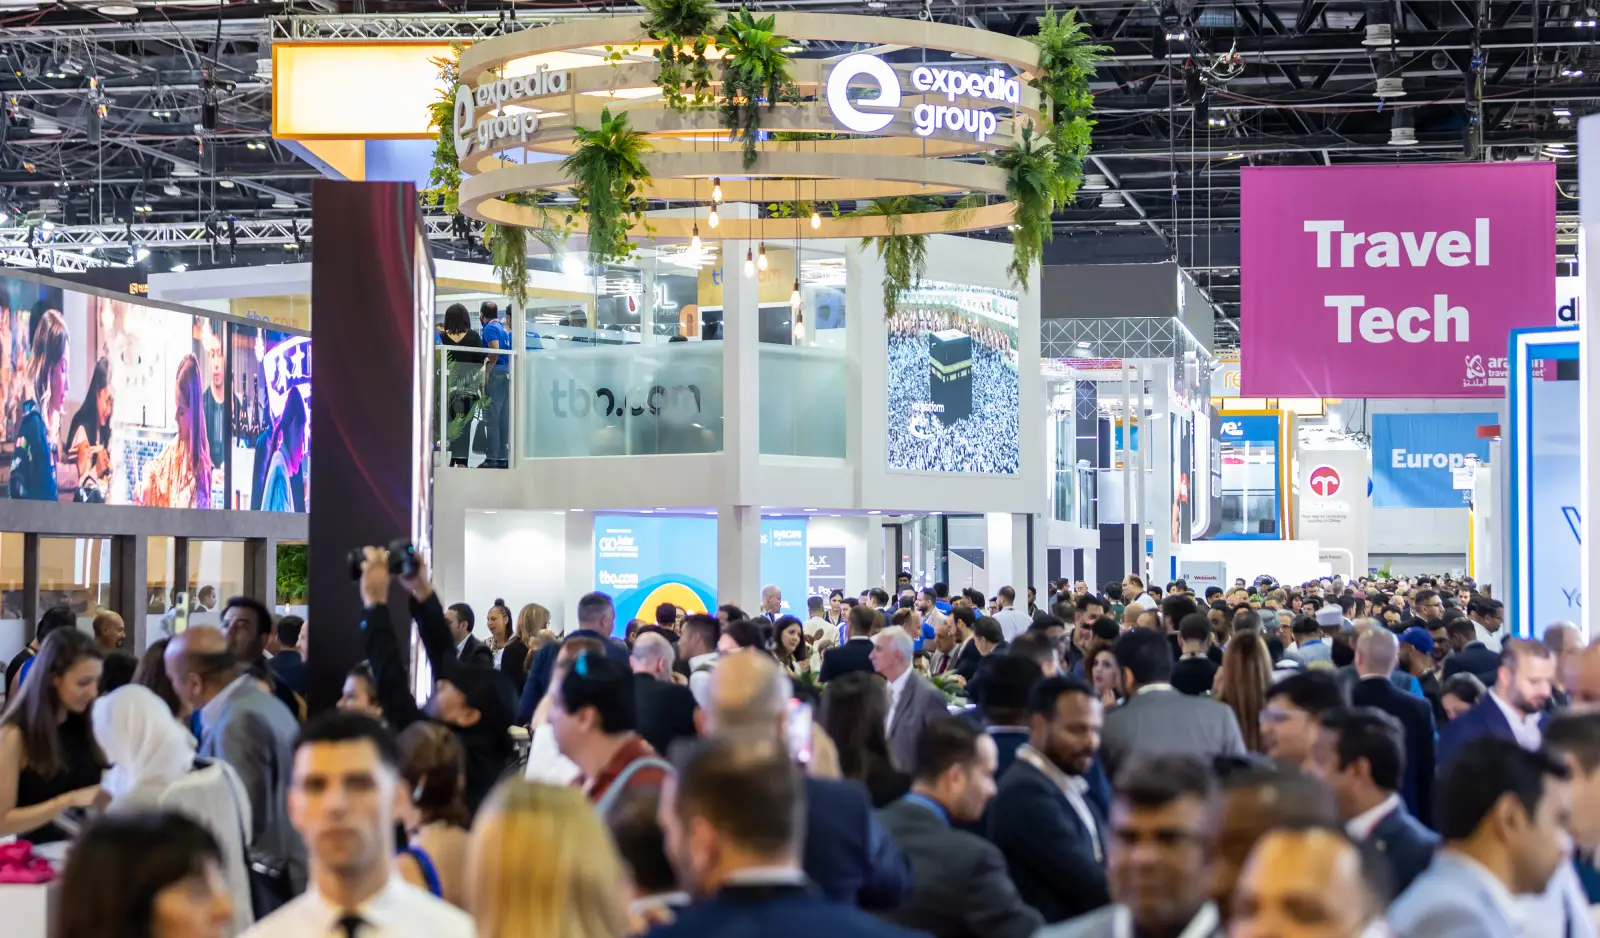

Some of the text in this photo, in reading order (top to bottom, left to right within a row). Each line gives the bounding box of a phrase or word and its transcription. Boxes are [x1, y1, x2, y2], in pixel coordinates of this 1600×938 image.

[476, 63, 569, 111] expedia
[912, 67, 1020, 104] expedia
[477, 112, 540, 151] group
[913, 103, 997, 142] group
[1304, 217, 1490, 268] Travel
[1324, 294, 1470, 344] Tech
[551, 378, 701, 419] tbo.com
